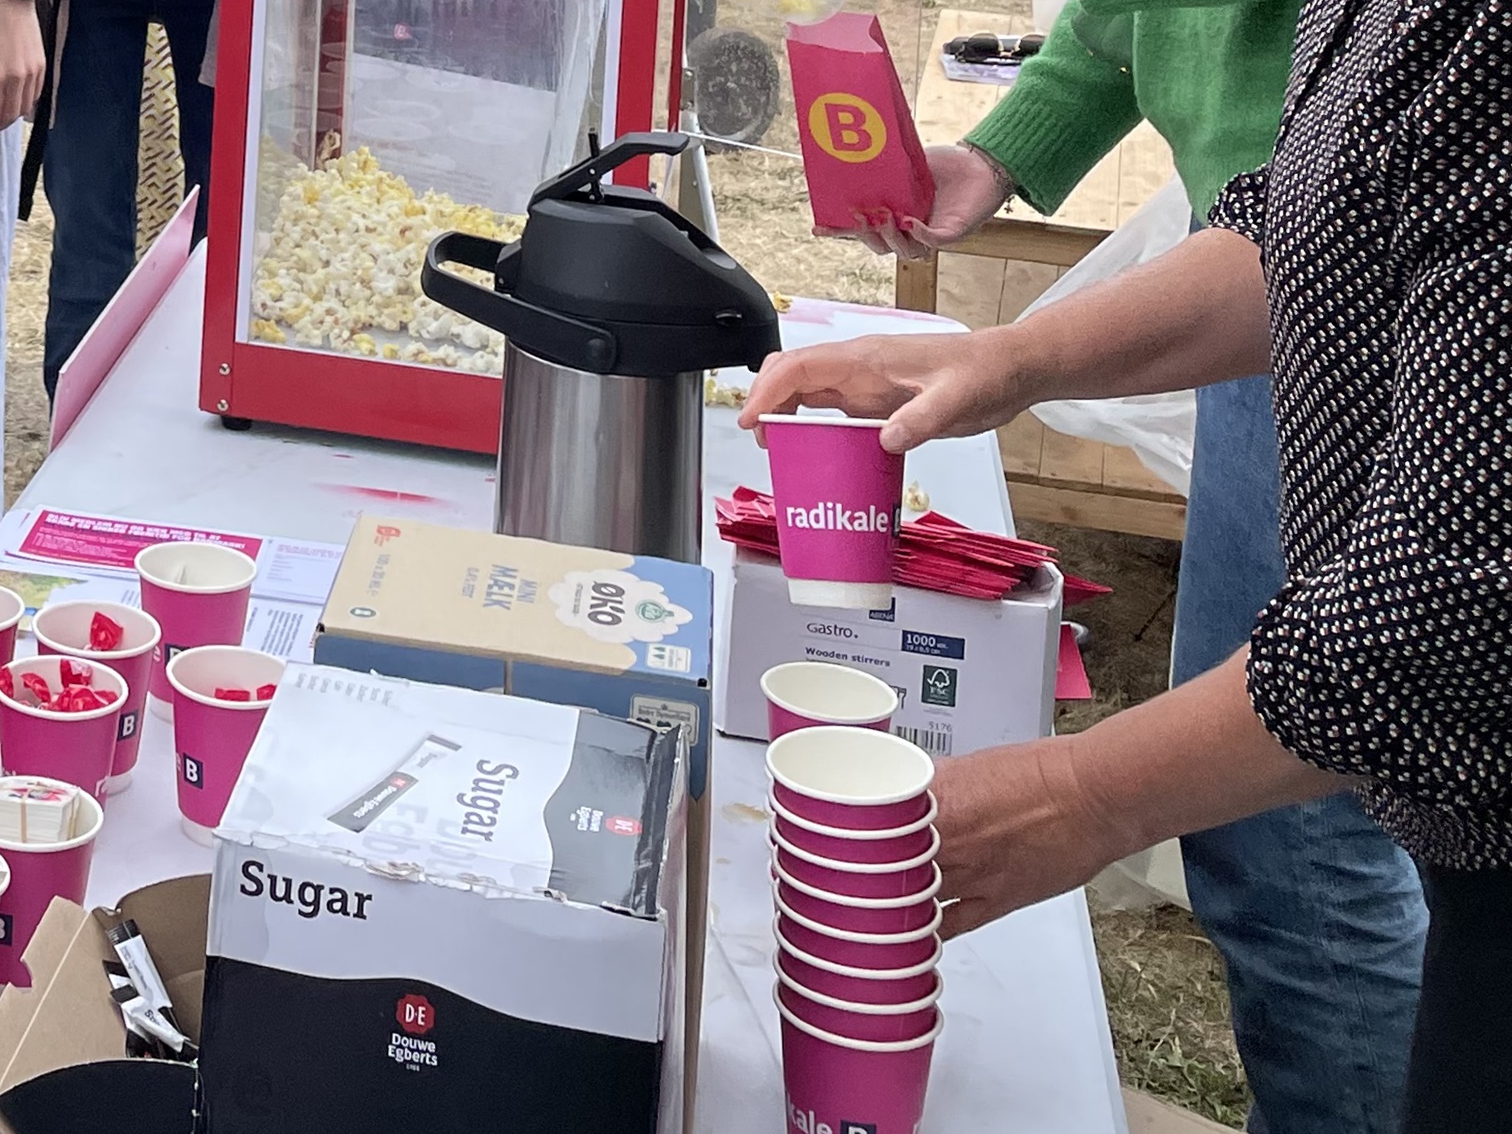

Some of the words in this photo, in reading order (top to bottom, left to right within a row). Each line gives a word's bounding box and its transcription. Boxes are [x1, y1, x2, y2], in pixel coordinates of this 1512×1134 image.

[824, 102, 873, 152] B
[787, 502, 889, 533] radikale
[481, 564, 520, 612] MÆLK
[587, 581, 626, 626] ØKO
[906, 633, 936, 647] 1000
[805, 647, 848, 661] Wooden
[851, 654, 891, 667] stirrers
[122, 715, 136, 736] B
[928, 721, 953, 733] 5176
[185, 758, 199, 782] B
[456, 759, 520, 842] Sugar
[239, 859, 373, 921] Sugar
[392, 1032, 436, 1053] Douwe
[388, 1045, 438, 1066] Egberts
